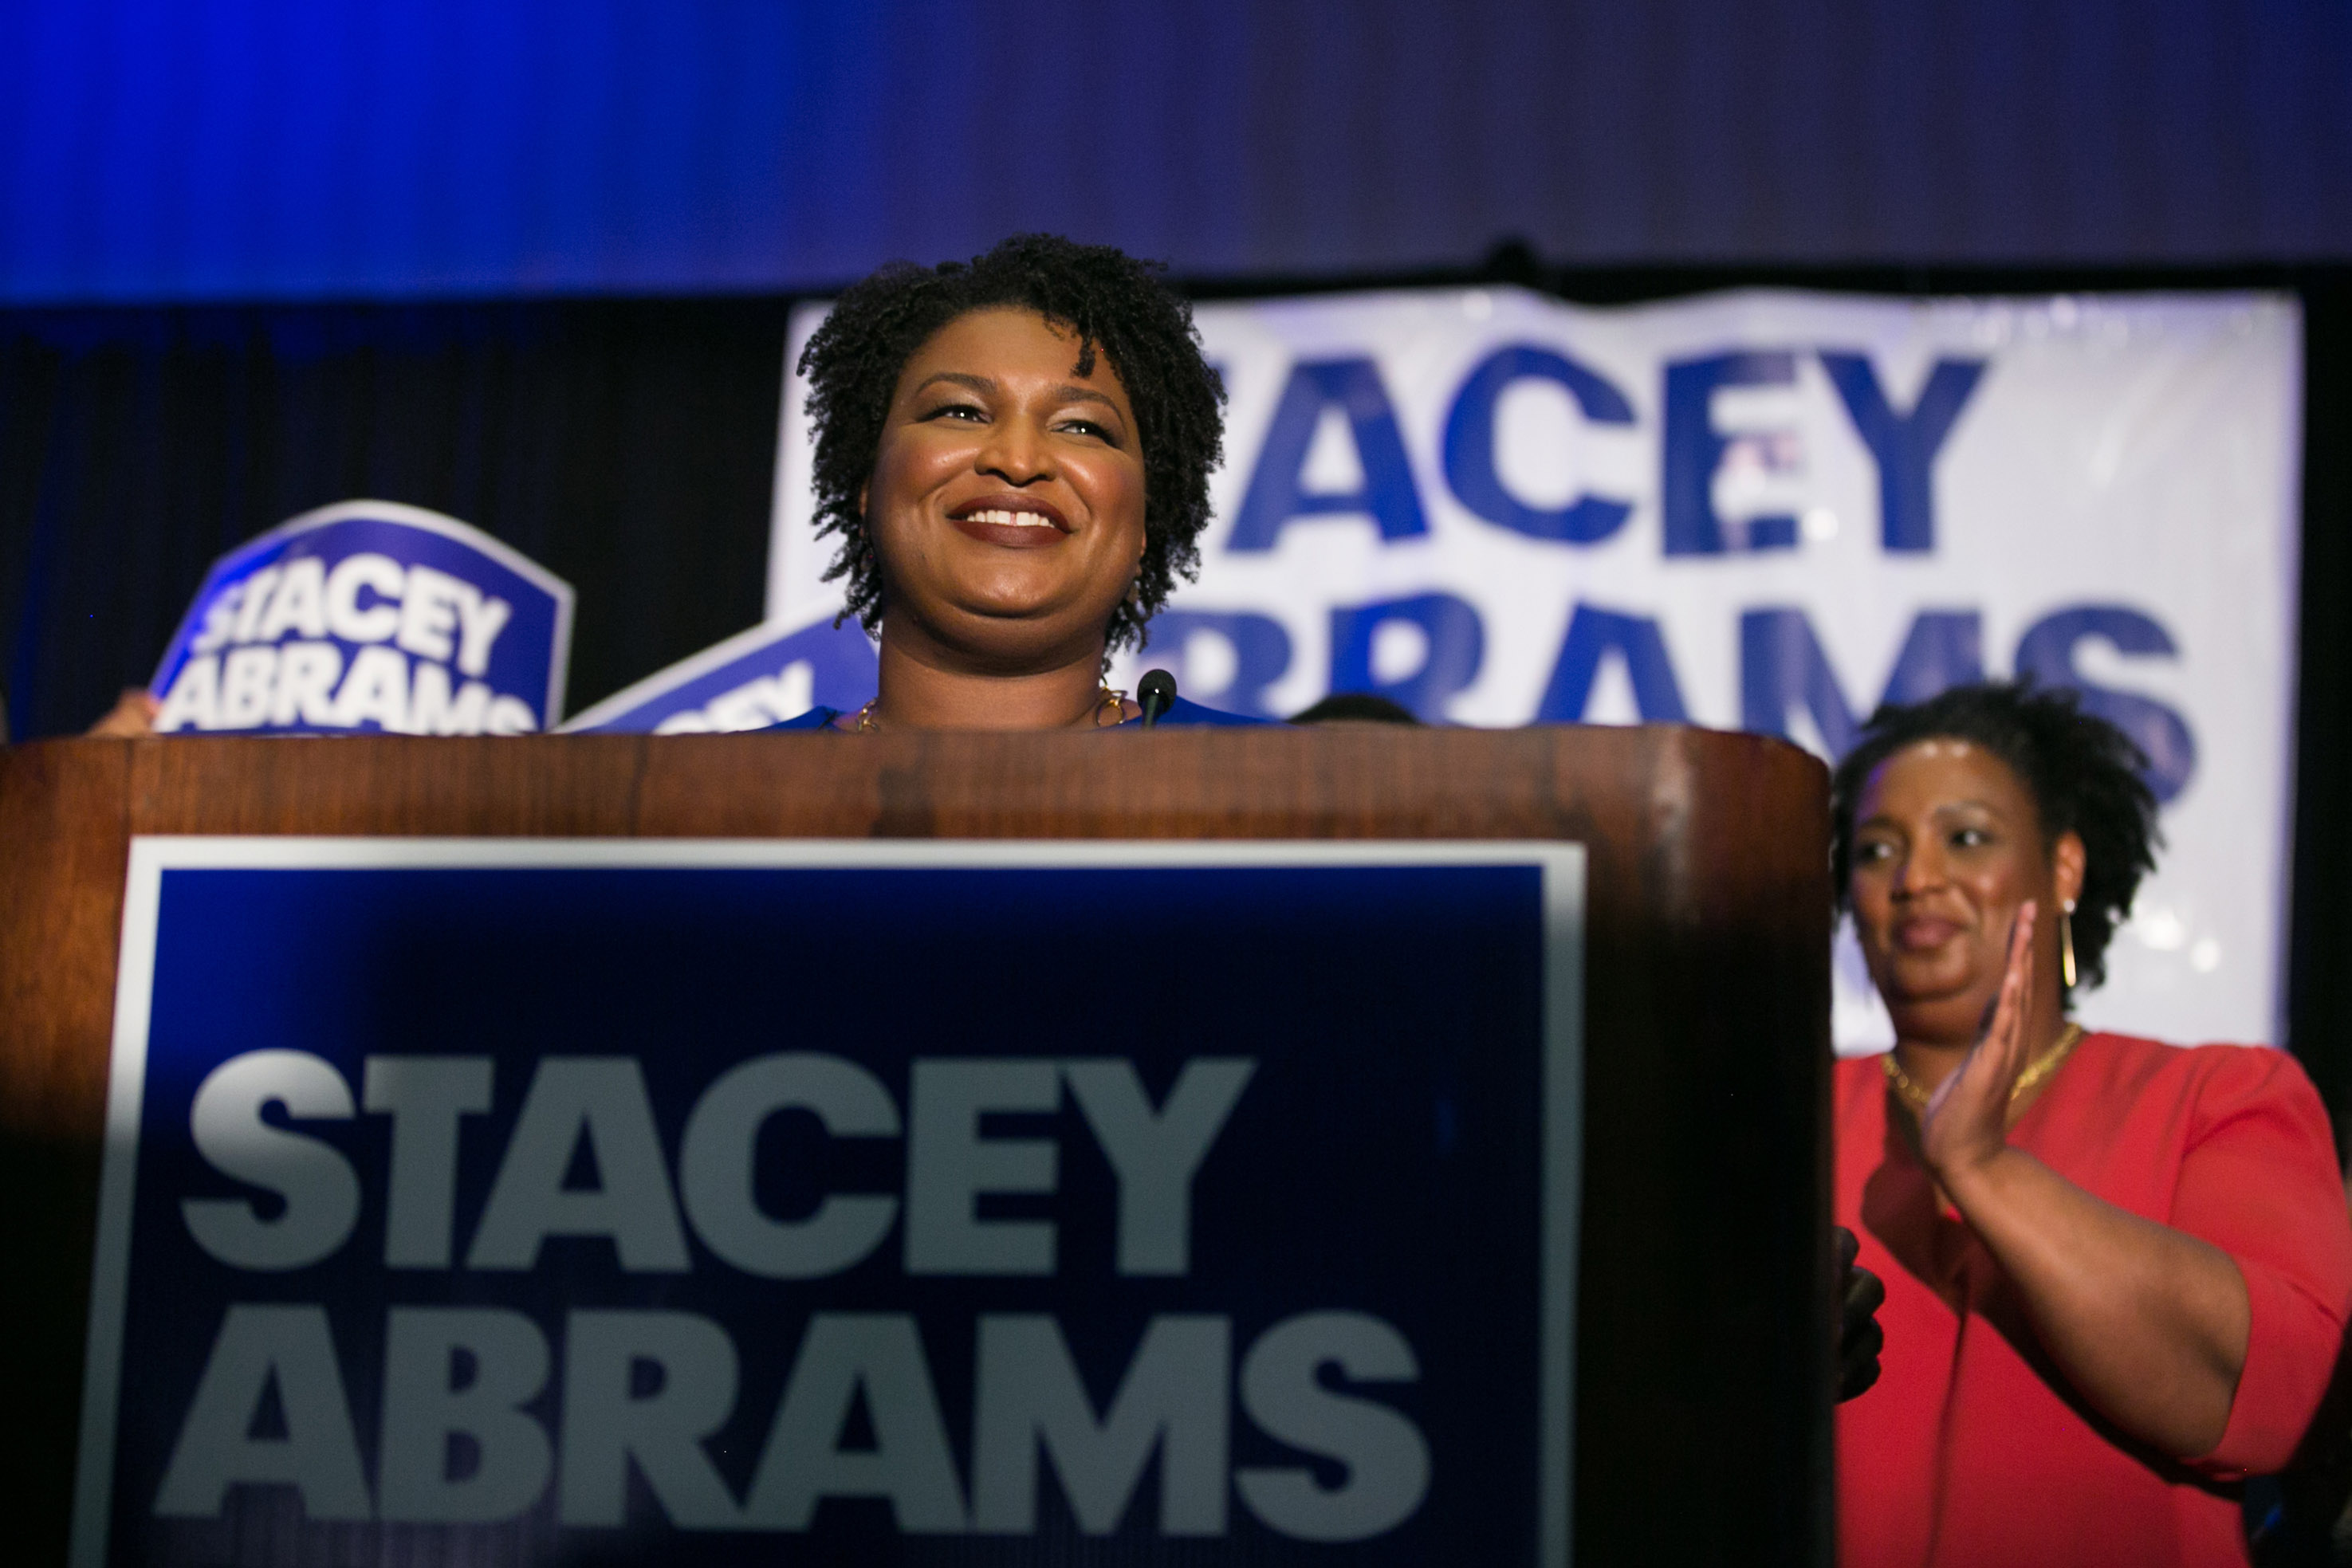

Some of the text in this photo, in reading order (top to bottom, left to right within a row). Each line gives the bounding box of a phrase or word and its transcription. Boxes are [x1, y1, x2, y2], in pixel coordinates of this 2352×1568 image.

[1209, 344, 1987, 560] ACEY
[191, 553, 513, 676] STACEY
[1143, 591, 2201, 805] RAMS
[180, 1048, 1258, 1279] STACEY
[153, 1304, 1432, 1543] ABRAMS
